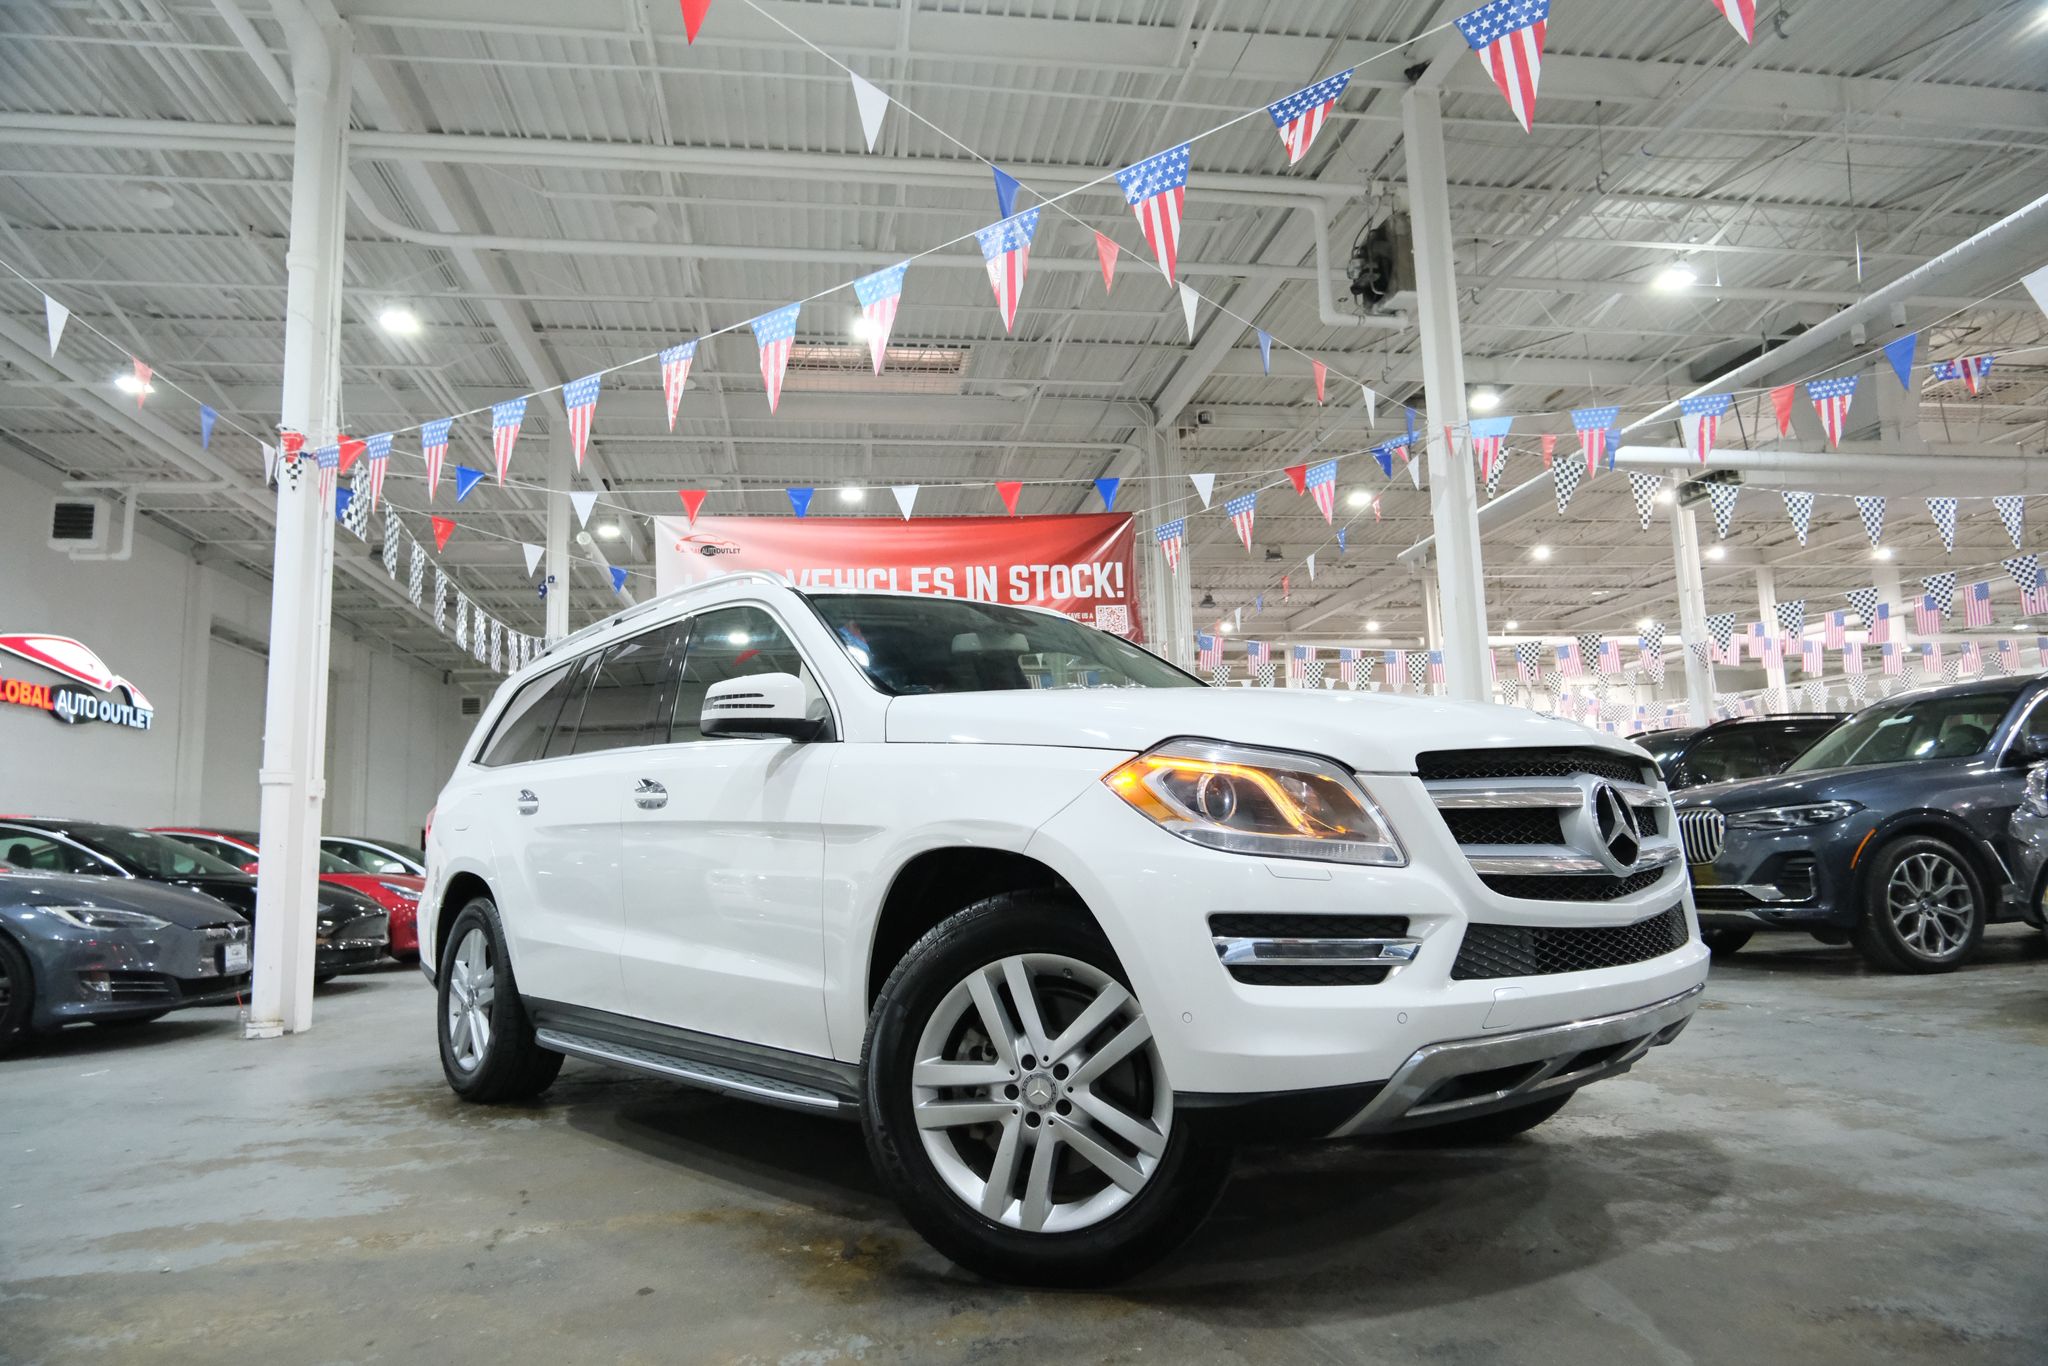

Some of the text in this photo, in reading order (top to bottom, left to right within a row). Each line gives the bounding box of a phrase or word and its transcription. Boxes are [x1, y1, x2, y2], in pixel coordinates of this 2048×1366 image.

[786, 562, 1125, 602] VEHICLES IN STOCK!
[0, 675, 154, 730] LOBAL AUTO OUTLET
